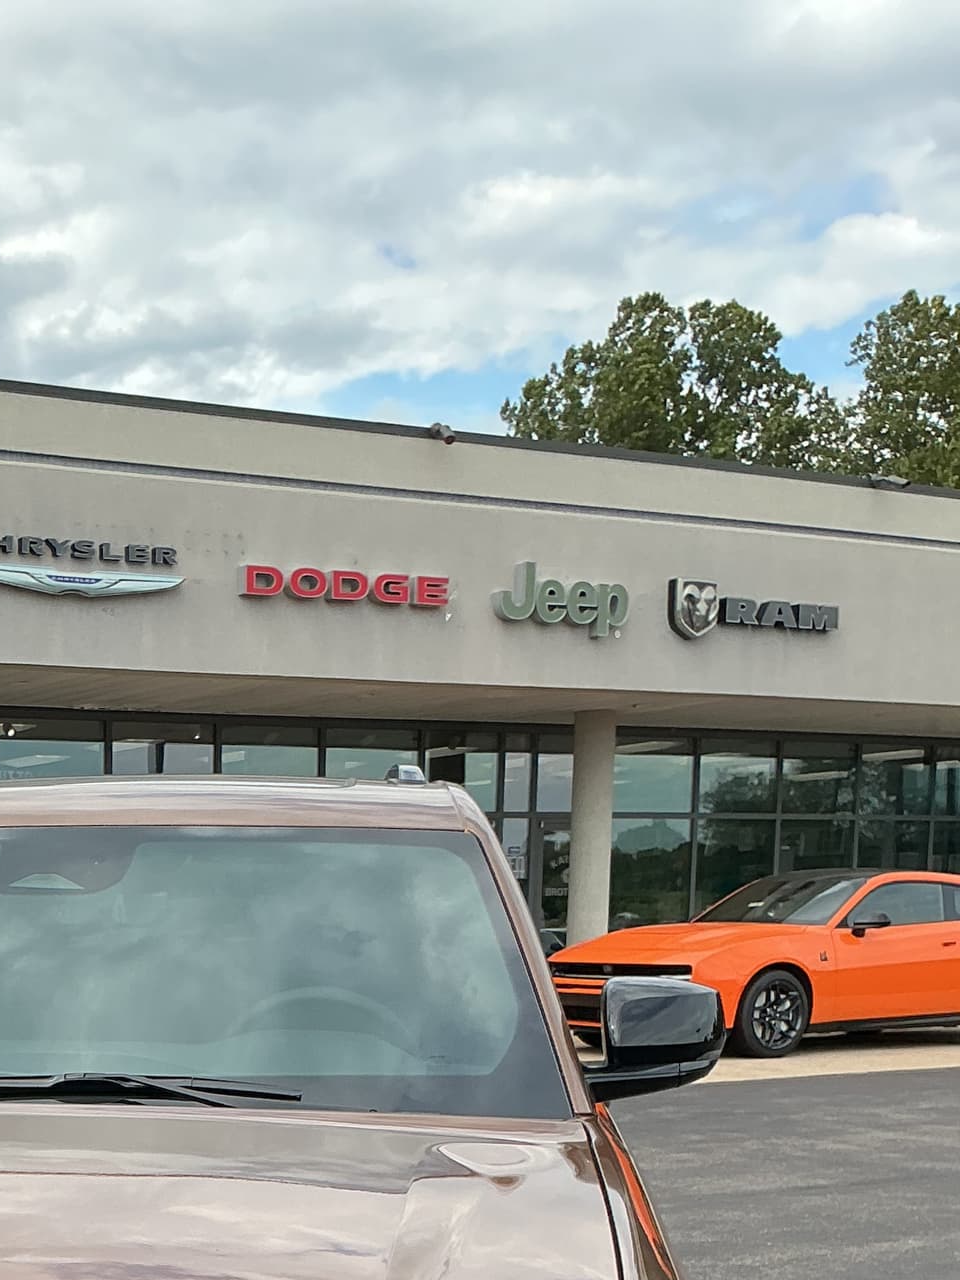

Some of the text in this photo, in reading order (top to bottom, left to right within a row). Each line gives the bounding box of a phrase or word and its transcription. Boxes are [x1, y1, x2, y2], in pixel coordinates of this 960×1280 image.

[238, 564, 450, 607] DODGE
[490, 561, 629, 638] Jeep
[719, 597, 839, 631] RAM
